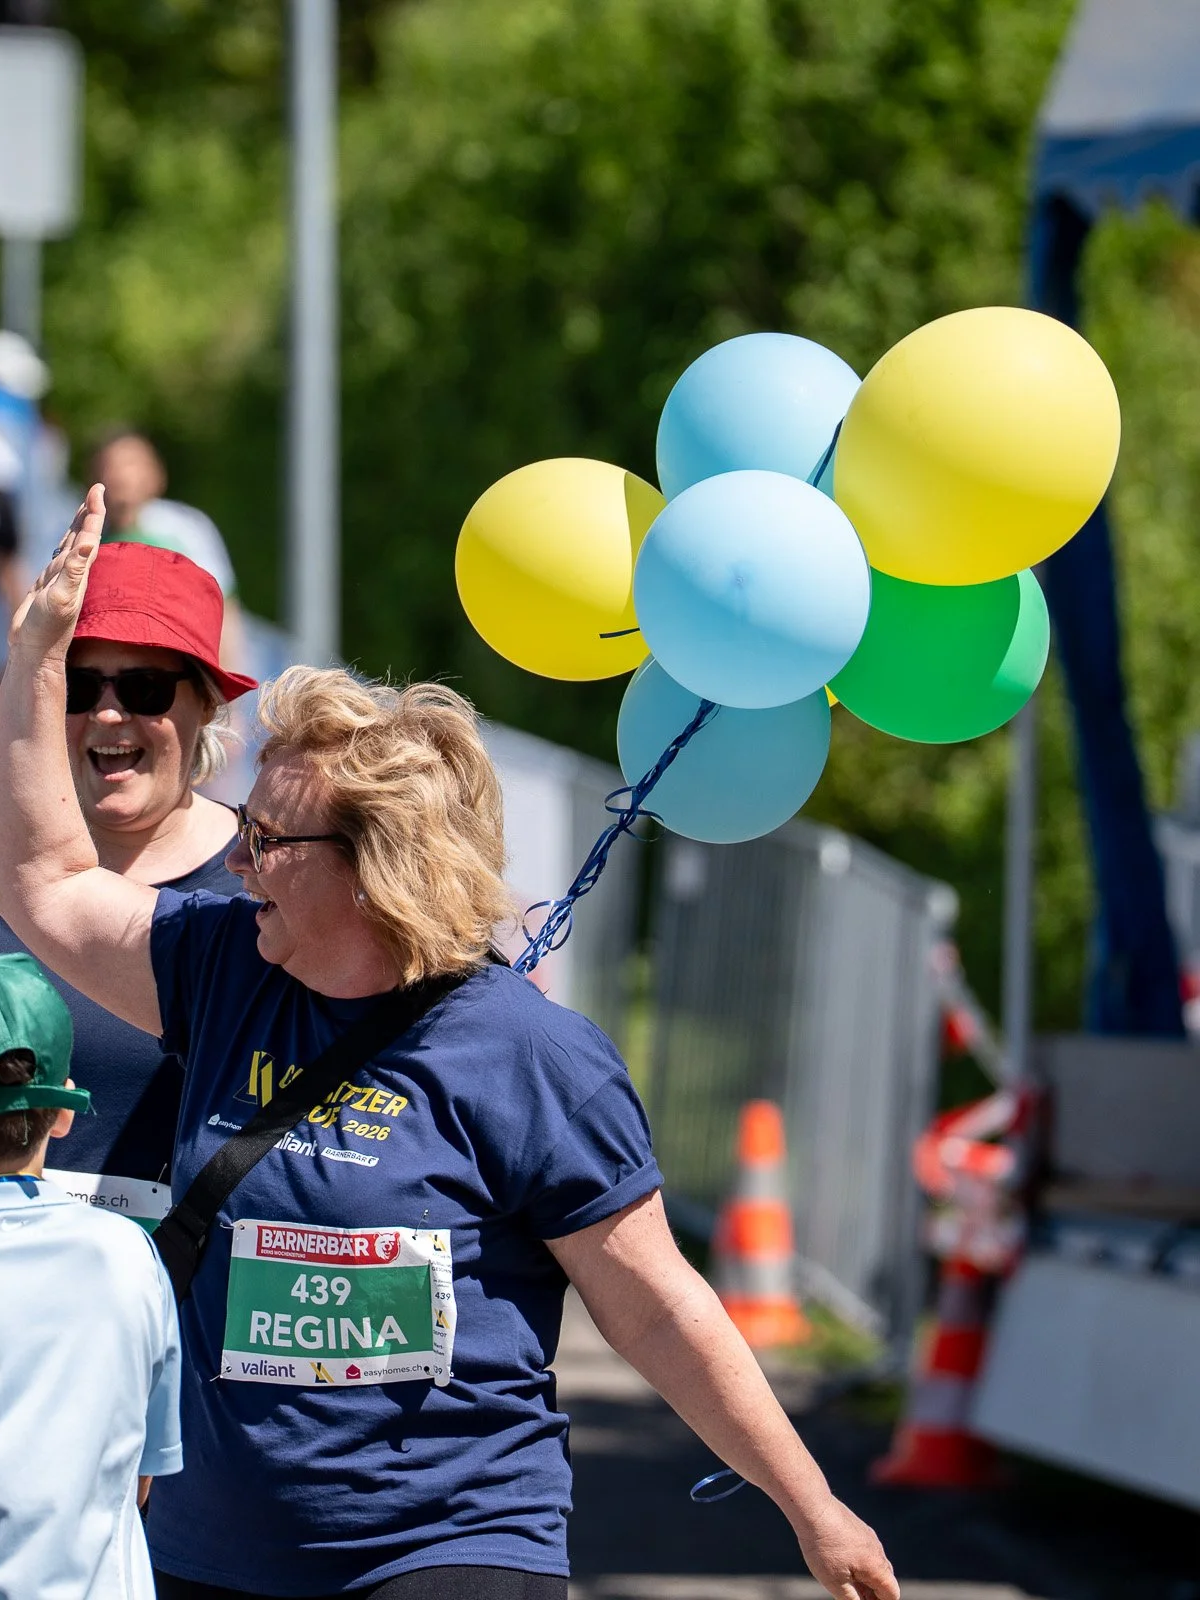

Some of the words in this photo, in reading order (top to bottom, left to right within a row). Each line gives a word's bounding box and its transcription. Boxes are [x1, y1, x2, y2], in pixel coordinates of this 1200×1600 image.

[218, 1120, 242, 1130] easyhom
[342, 1120, 391, 1141] 2026
[261, 1228, 370, 1257] BÄRNERBÄR
[290, 1273, 352, 1306] 439
[434, 1291, 451, 1300] 439
[250, 1310, 408, 1350] REGINA
[241, 1360, 296, 1378] valiant
[363, 1364, 423, 1377] easyhomes.ch
